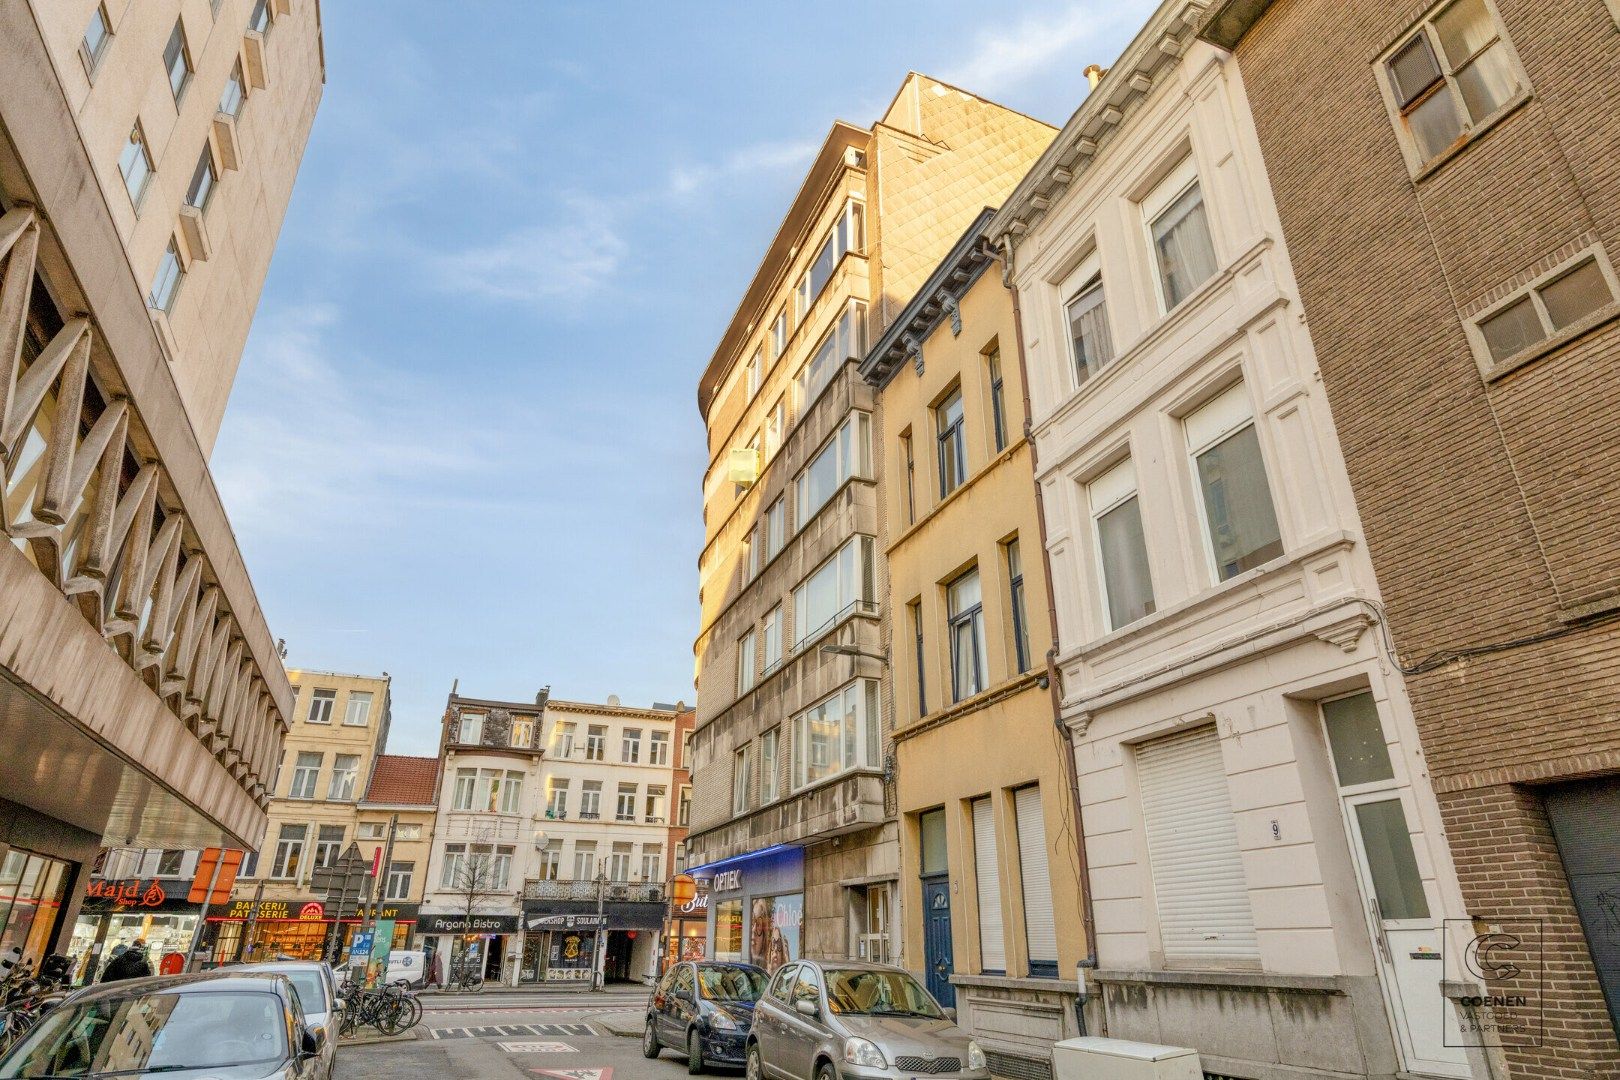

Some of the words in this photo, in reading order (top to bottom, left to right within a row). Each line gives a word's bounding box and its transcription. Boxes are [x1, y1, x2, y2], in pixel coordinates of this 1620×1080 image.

[1272, 824, 1278, 835] 9
[714, 869, 742, 892] OPTIEK
[87, 880, 139, 902] Majd
[118, 898, 137, 906] Shop
[229, 910, 289, 919] PATSERIE
[434, 919, 471, 930] Argano
[473, 919, 501, 929] Bistro
[576, 917, 607, 925] SOULAIMN
[353, 934, 364, 948] P
